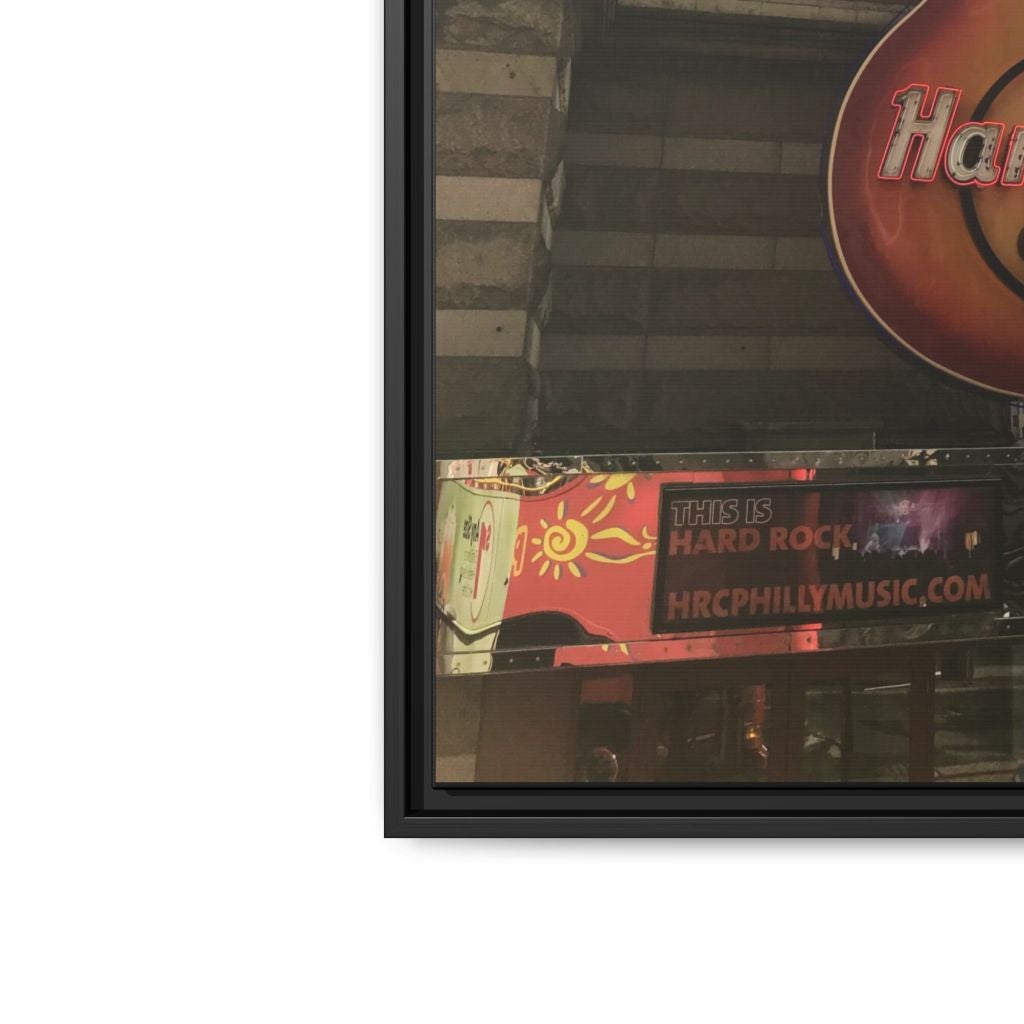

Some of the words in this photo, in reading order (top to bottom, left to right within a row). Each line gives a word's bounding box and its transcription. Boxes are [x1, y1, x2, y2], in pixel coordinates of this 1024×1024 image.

[671, 499, 740, 527] THIS
[745, 497, 774, 524] IS
[668, 527, 761, 556] HARD
[666, 574, 992, 620] HRCPHILLYMUSIC.COM
